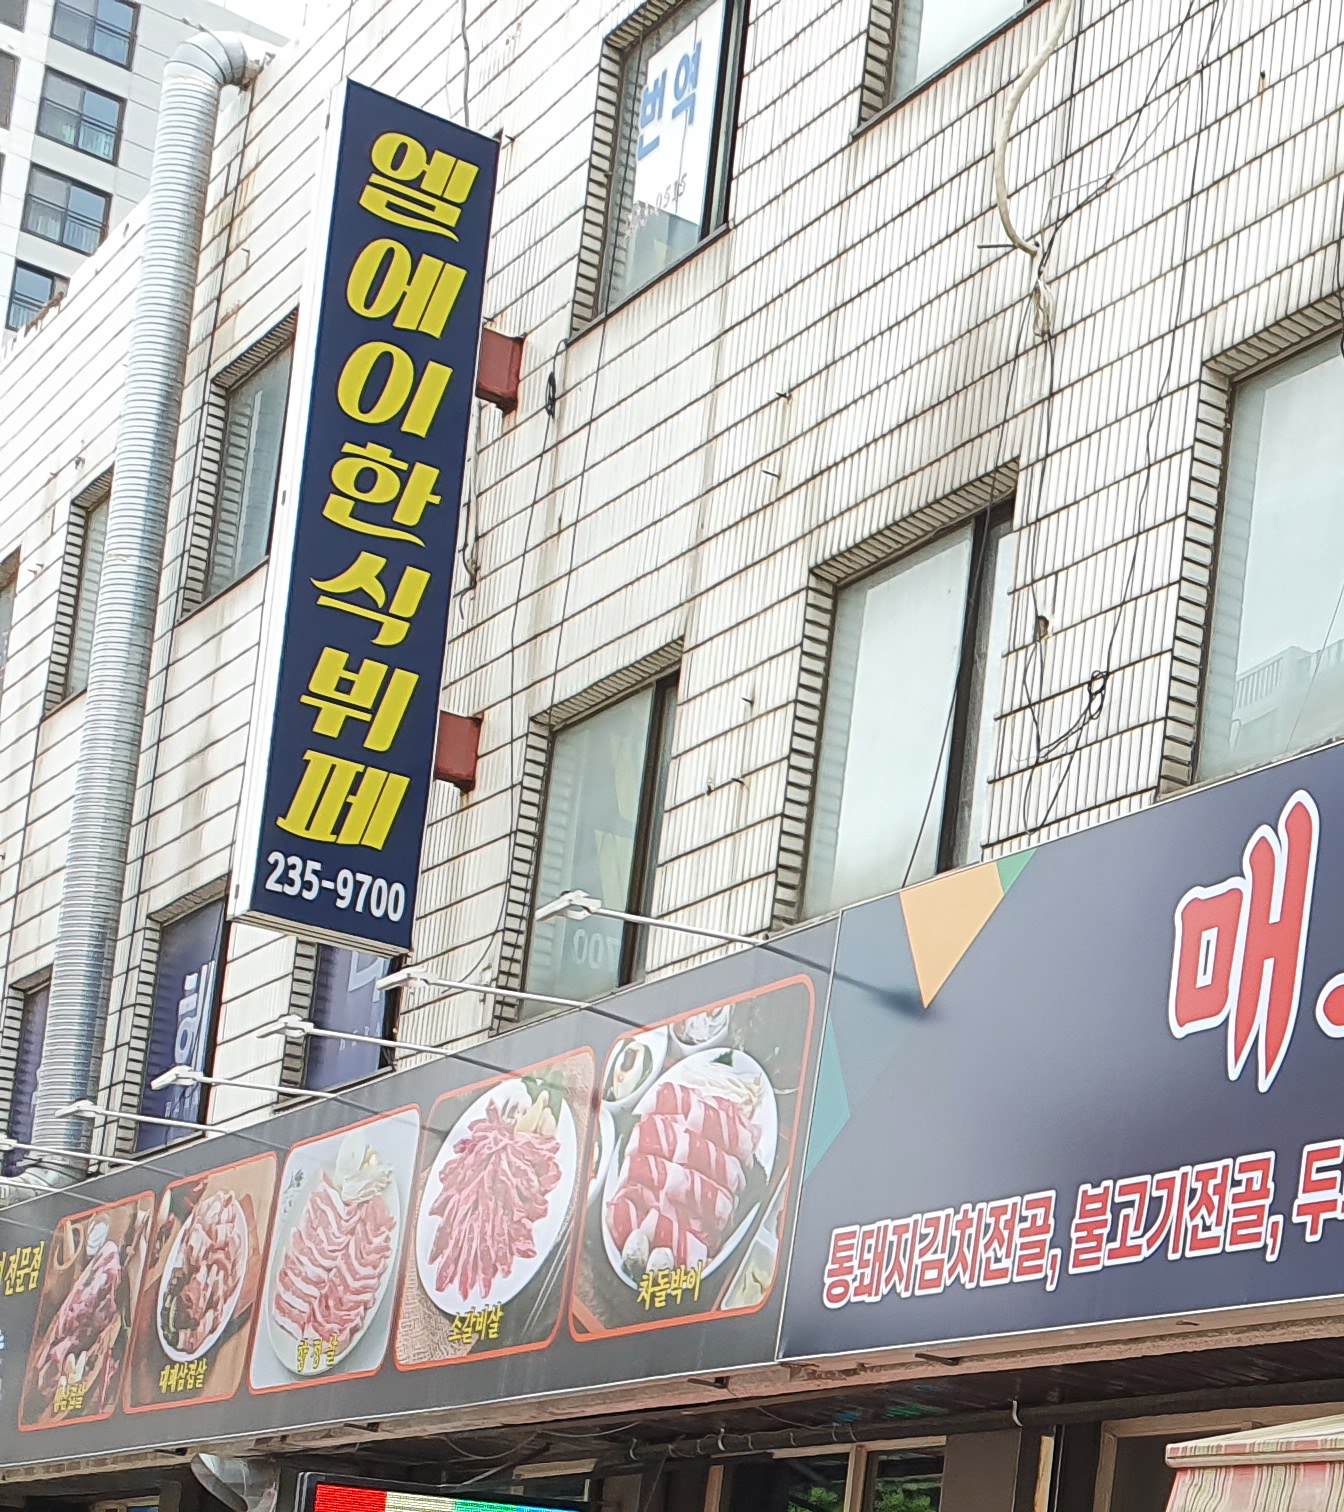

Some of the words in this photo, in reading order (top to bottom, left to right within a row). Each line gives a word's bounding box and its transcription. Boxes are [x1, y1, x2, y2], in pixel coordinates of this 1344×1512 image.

[276, 131, 480, 851] 엘에이한식뷔페
[265, 849, 407, 923] 235-9700
[823, 1190, 1059, 1310] 통돼지김치전골,
[1069, 1151, 1283, 1274] 불고기전골,
[637, 1260, 703, 1311] 차돌박이
[448, 1301, 504, 1344] 소갈비살
[158, 1358, 208, 1394] 대패삼겹살
